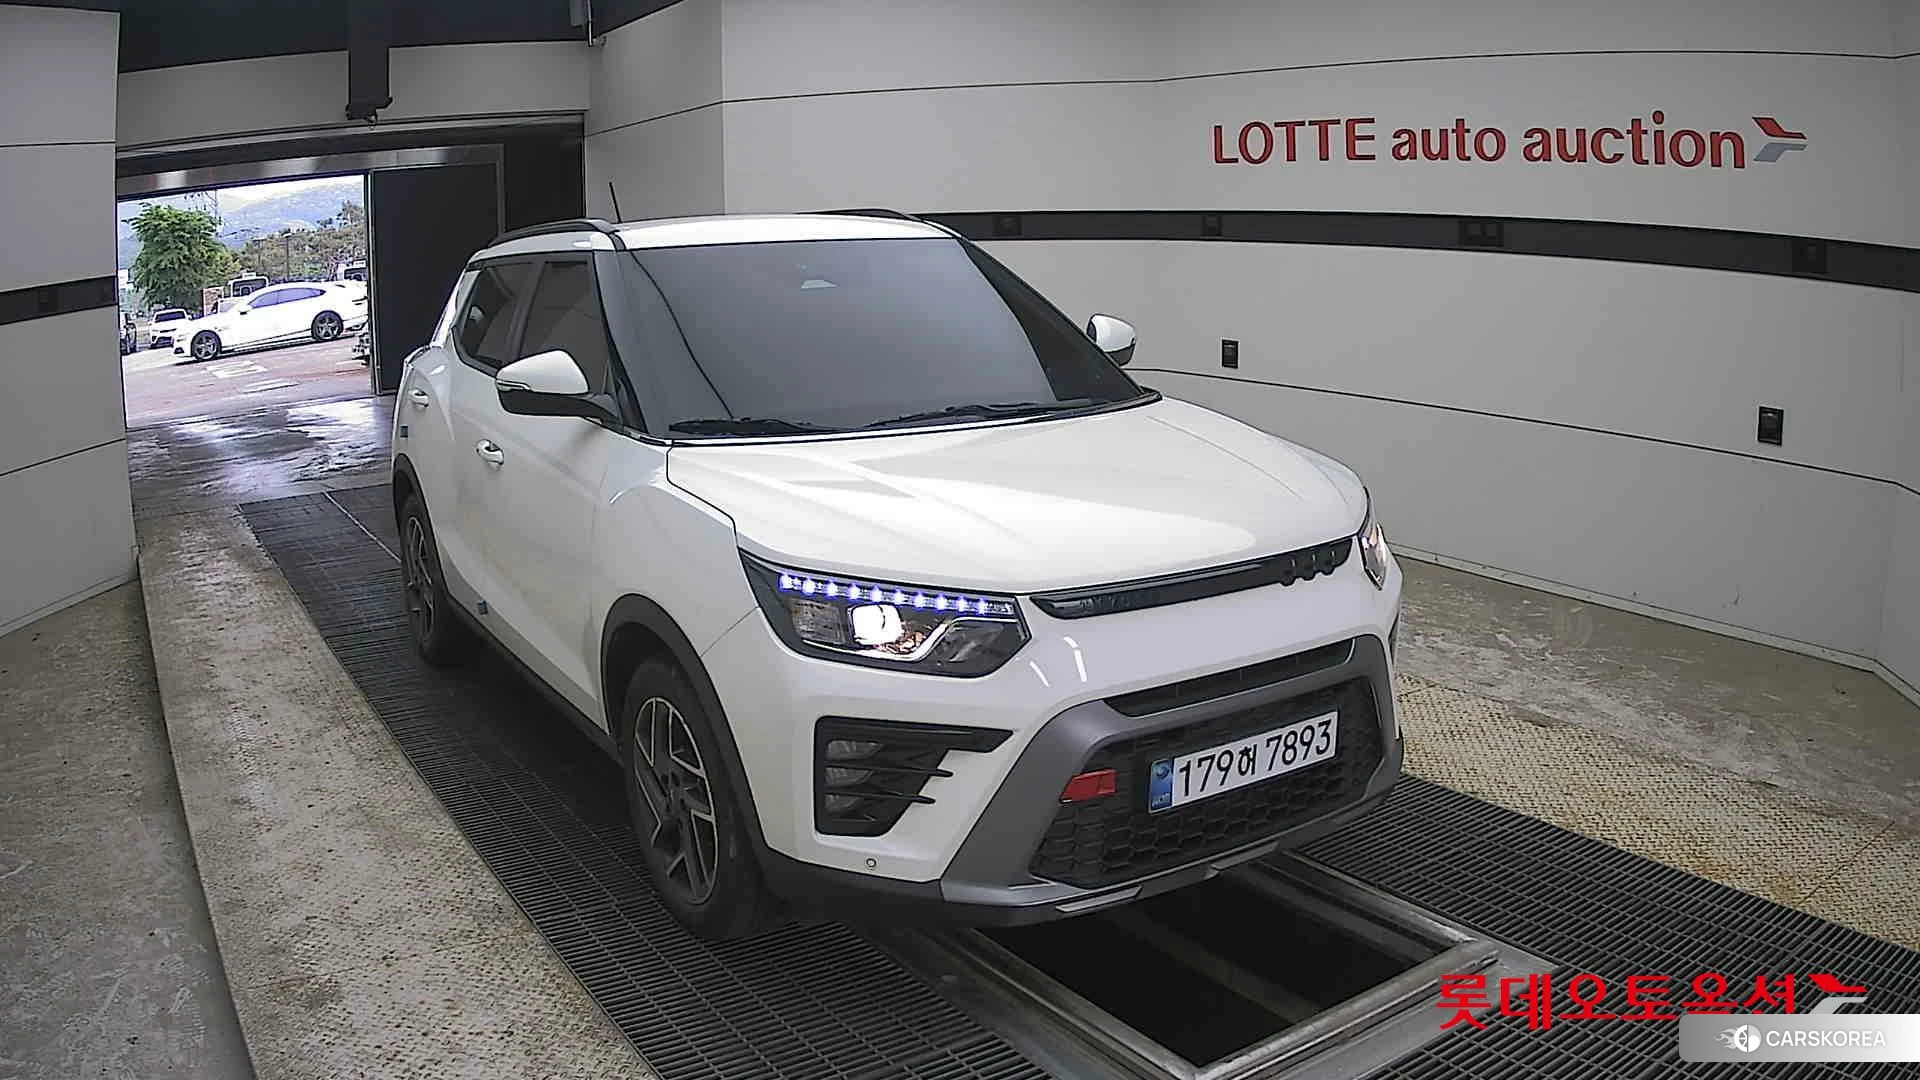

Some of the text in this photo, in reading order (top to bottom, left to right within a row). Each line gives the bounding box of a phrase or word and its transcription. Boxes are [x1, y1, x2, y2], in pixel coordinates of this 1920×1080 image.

[1213, 110, 1747, 169] LOTTE auto auction
[1265, 719, 1332, 772] 7893
